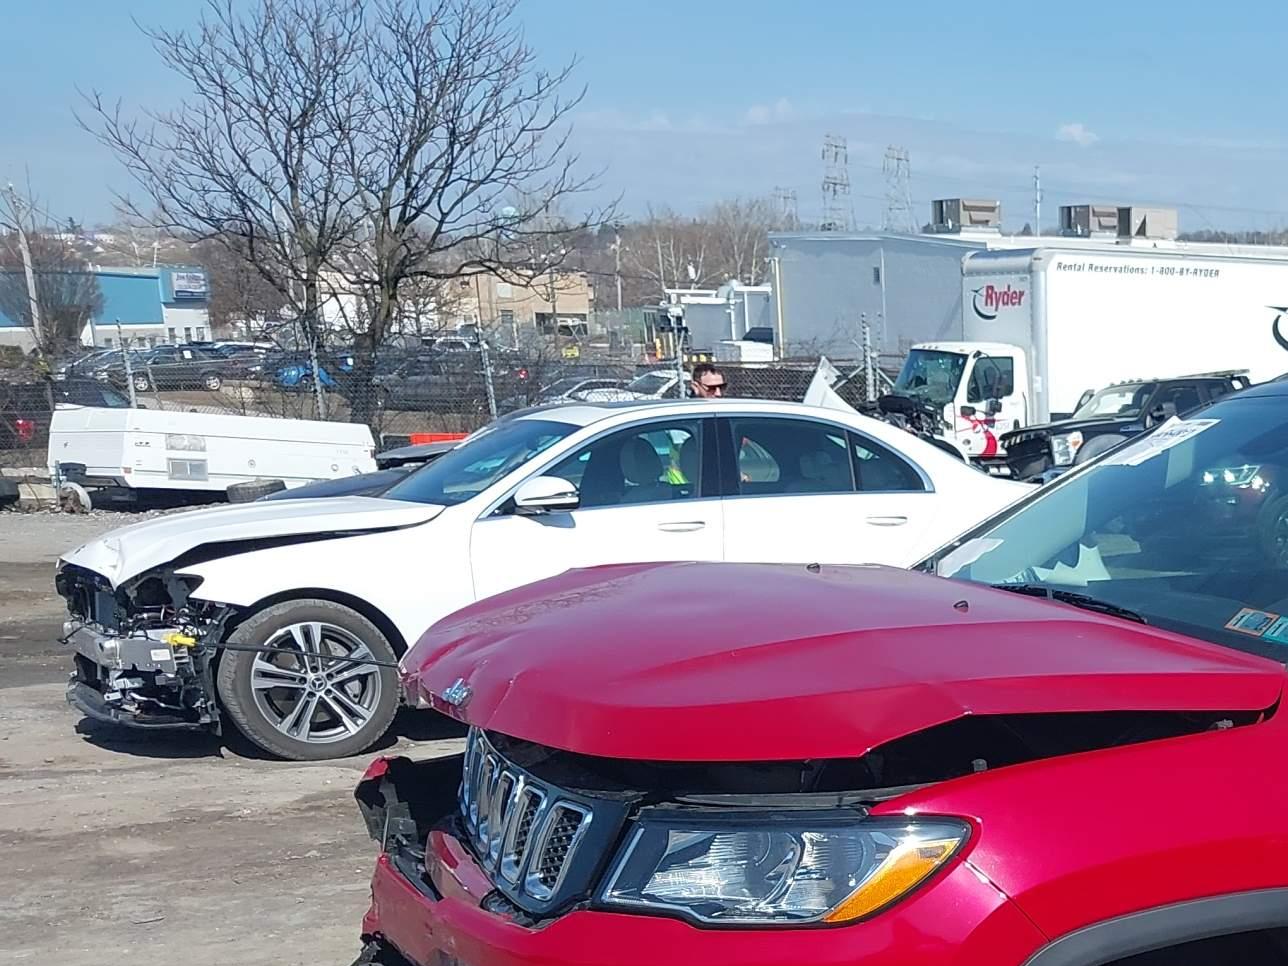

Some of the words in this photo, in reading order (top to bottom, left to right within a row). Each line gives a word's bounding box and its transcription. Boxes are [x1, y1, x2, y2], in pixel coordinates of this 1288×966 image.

[1056, 262, 1086, 273] Rental
[1088, 263, 1148, 275] Reservations:
[985, 284, 1025, 312] Ryder
